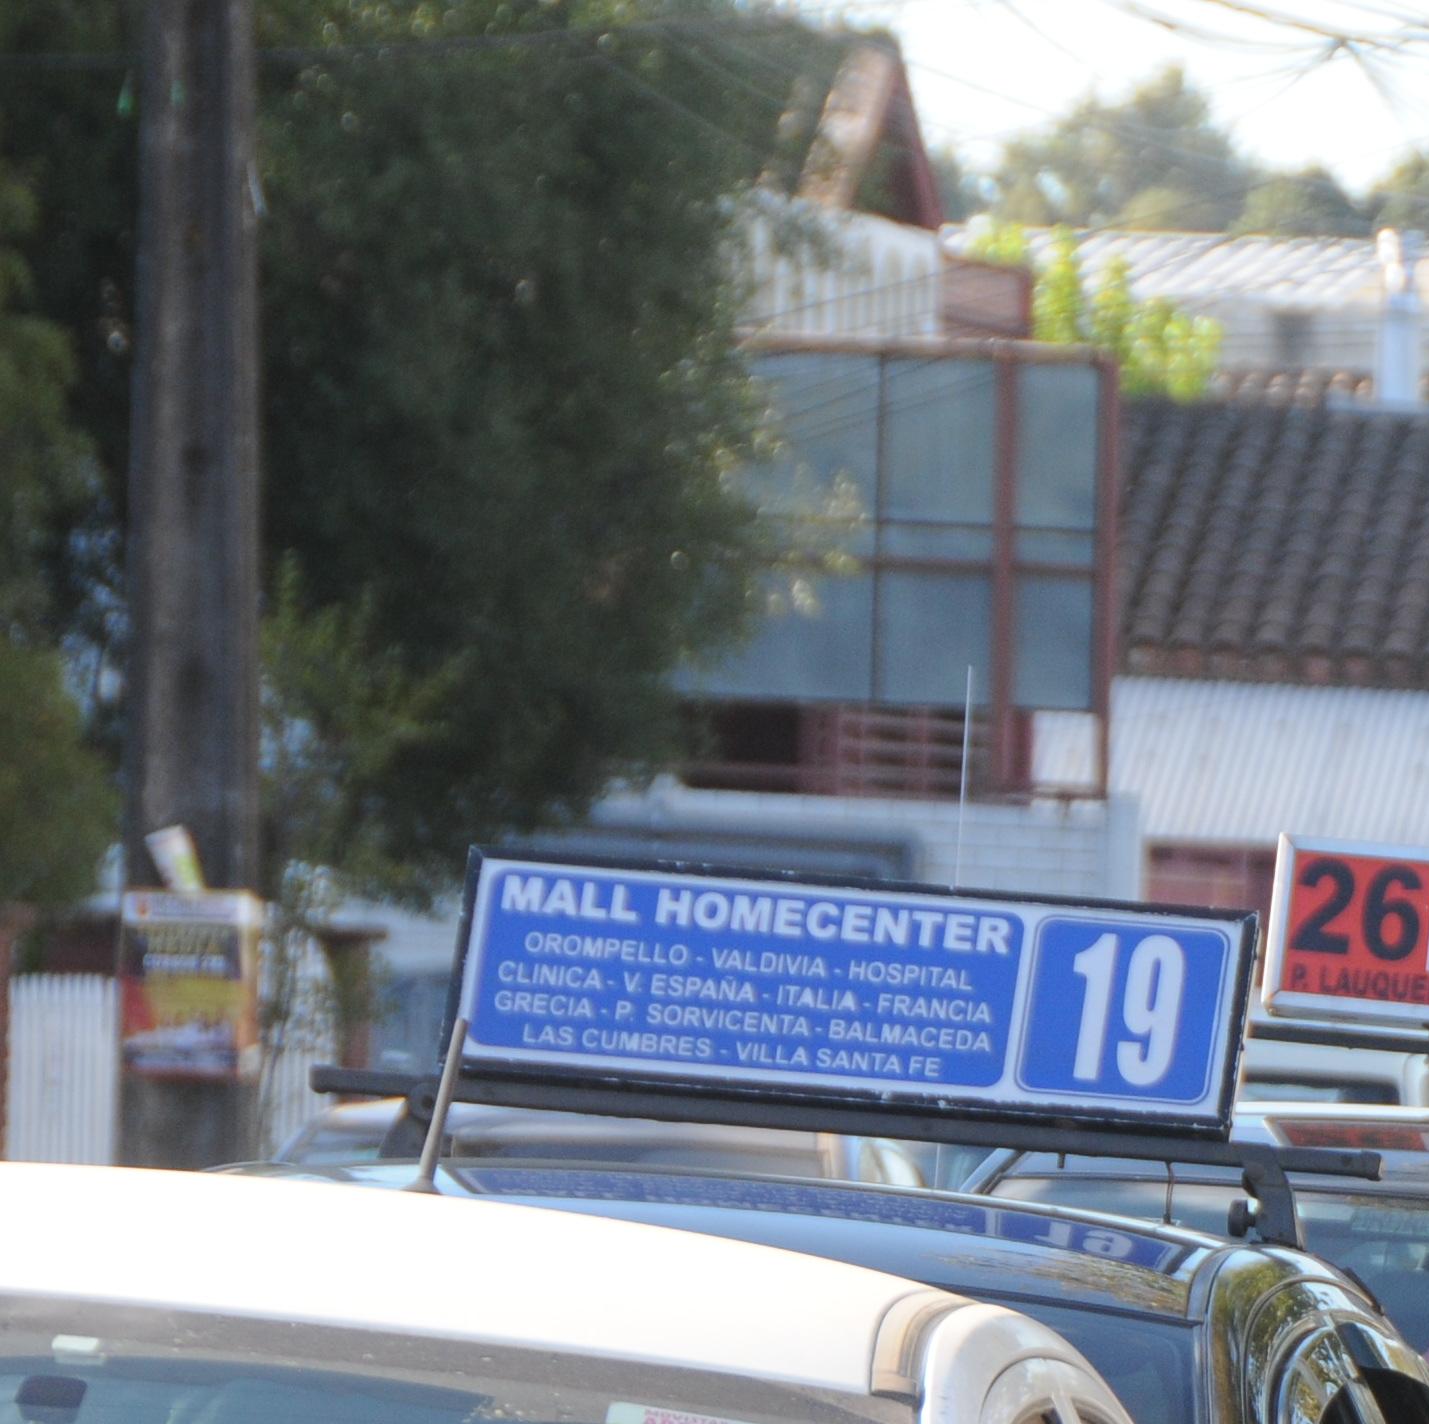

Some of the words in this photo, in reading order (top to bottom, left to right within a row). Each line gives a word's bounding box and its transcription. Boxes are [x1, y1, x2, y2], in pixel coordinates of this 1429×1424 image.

[501, 874, 638, 922] MALL
[654, 886, 1012, 955] HOMECENTER
[1290, 856, 1423, 961] 26
[497, 960, 603, 990] CLINICA
[623, 971, 643, 993] V.
[650, 972, 755, 1003] ESPAÑA
[776, 984, 857, 1012] ITALIA
[876, 993, 992, 1024] FRANCIA
[523, 930, 689, 966] OROMPELLO
[711, 945, 827, 978] VALDIVIA
[848, 959, 974, 991] HOSPITAL
[1291, 962, 1310, 990] P.
[494, 989, 593, 1018] GRECIA
[614, 1000, 634, 1022] P.
[646, 1002, 810, 1036] SORVICENTA
[828, 1018, 992, 1052] BALMACEDA
[1072, 932, 1185, 1087] 19
[522, 1023, 575, 1046] LAS
[582, 1027, 713, 1058] CUMBRES
[735, 1041, 810, 1066] VILLA
[815, 1048, 901, 1074] SANTA
[908, 1056, 942, 1077] FE
